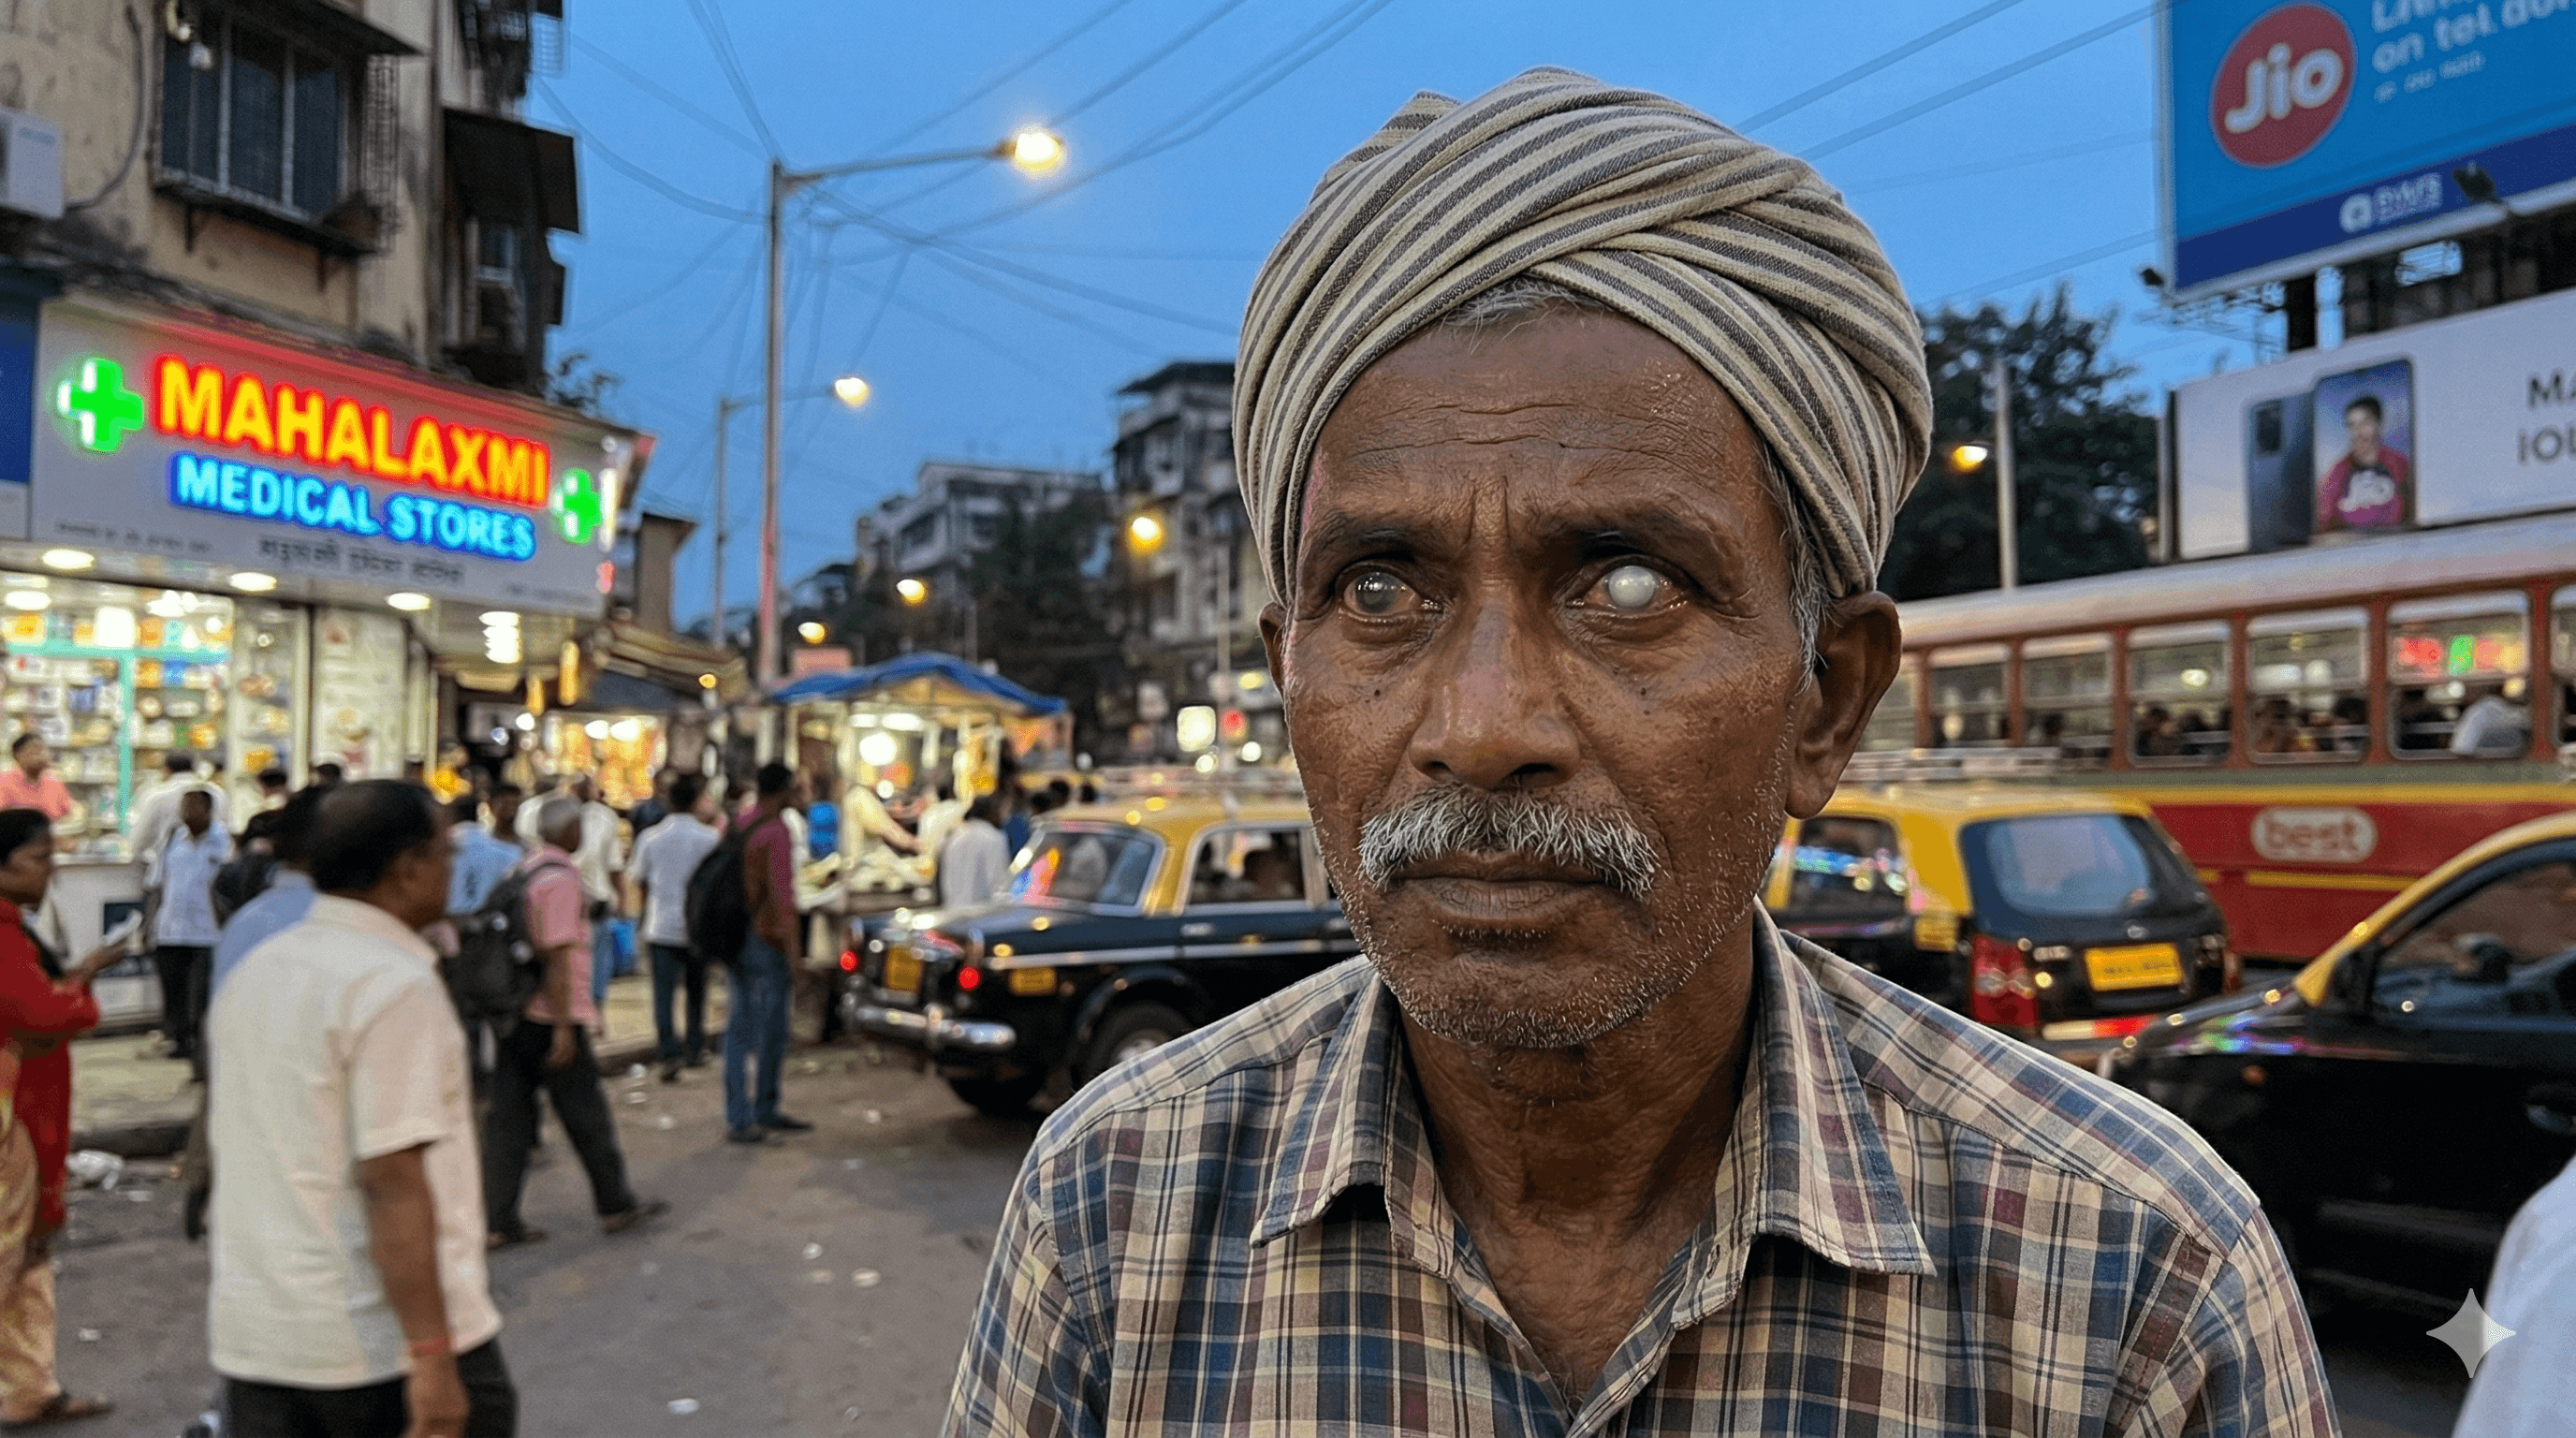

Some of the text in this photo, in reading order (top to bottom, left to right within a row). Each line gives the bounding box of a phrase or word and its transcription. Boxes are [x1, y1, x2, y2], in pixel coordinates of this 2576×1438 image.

[2225, 42, 2344, 133] Jio
[158, 357, 549, 506] MAHALAXMI
[175, 451, 385, 536] MEDICAL
[388, 493, 535, 562] STORES
[2262, 813, 2360, 857] best
